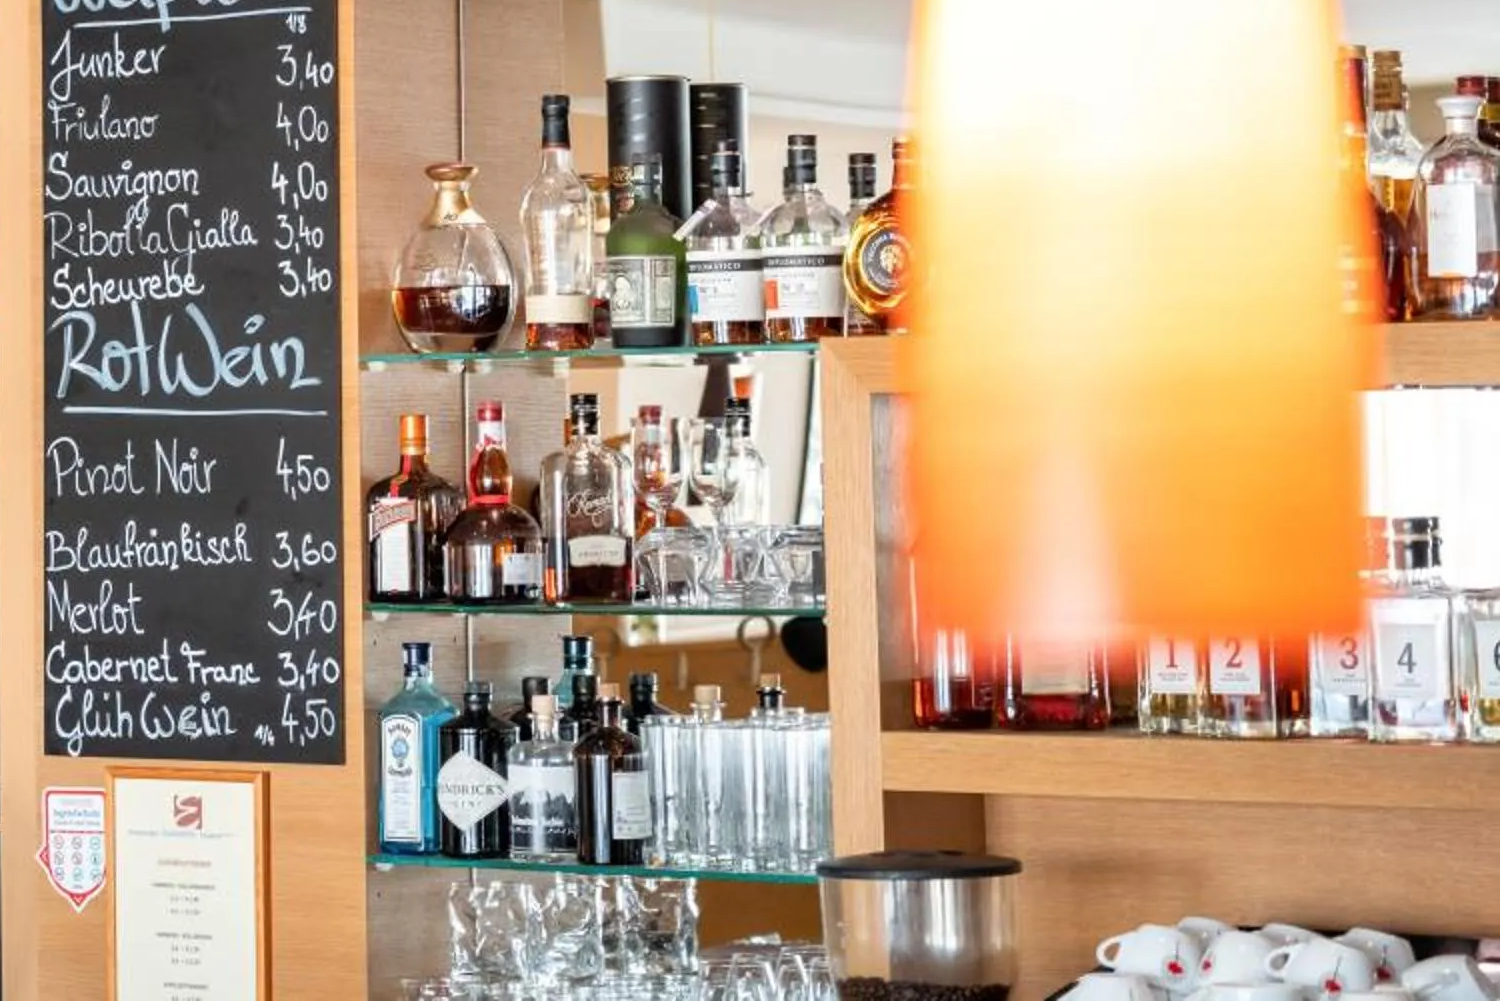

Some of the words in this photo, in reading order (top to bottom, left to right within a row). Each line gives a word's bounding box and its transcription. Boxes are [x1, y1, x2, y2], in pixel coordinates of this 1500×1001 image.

[50, 29, 166, 101] Junker
[275, 45, 334, 89] 3,40
[47, 95, 159, 142] Friulano
[276, 102, 329, 151] 4,00
[46, 151, 200, 225] Sauvignon
[271, 161, 328, 210] 4,00
[274, 214, 325, 254] 3,40
[51, 259, 205, 309] Scheurebe
[278, 257, 332, 297] 3,40
[47, 436, 145, 497] Pinot
[155, 437, 217, 494] Noir
[276, 438, 331, 500] 4,50
[46, 519, 252, 572] Blaufränkisch
[272, 531, 337, 572] 3,60
[47, 579, 144, 635] Merlot
[46, 638, 178, 684] Cabernet
[180, 642, 261, 685] Franc
[277, 649, 339, 691] 3,40
[1225, 637, 1242, 668] 2
[1340, 636, 1358, 670] 3
[1397, 642, 1417, 674] 4
[282, 693, 336, 746] 4,50
